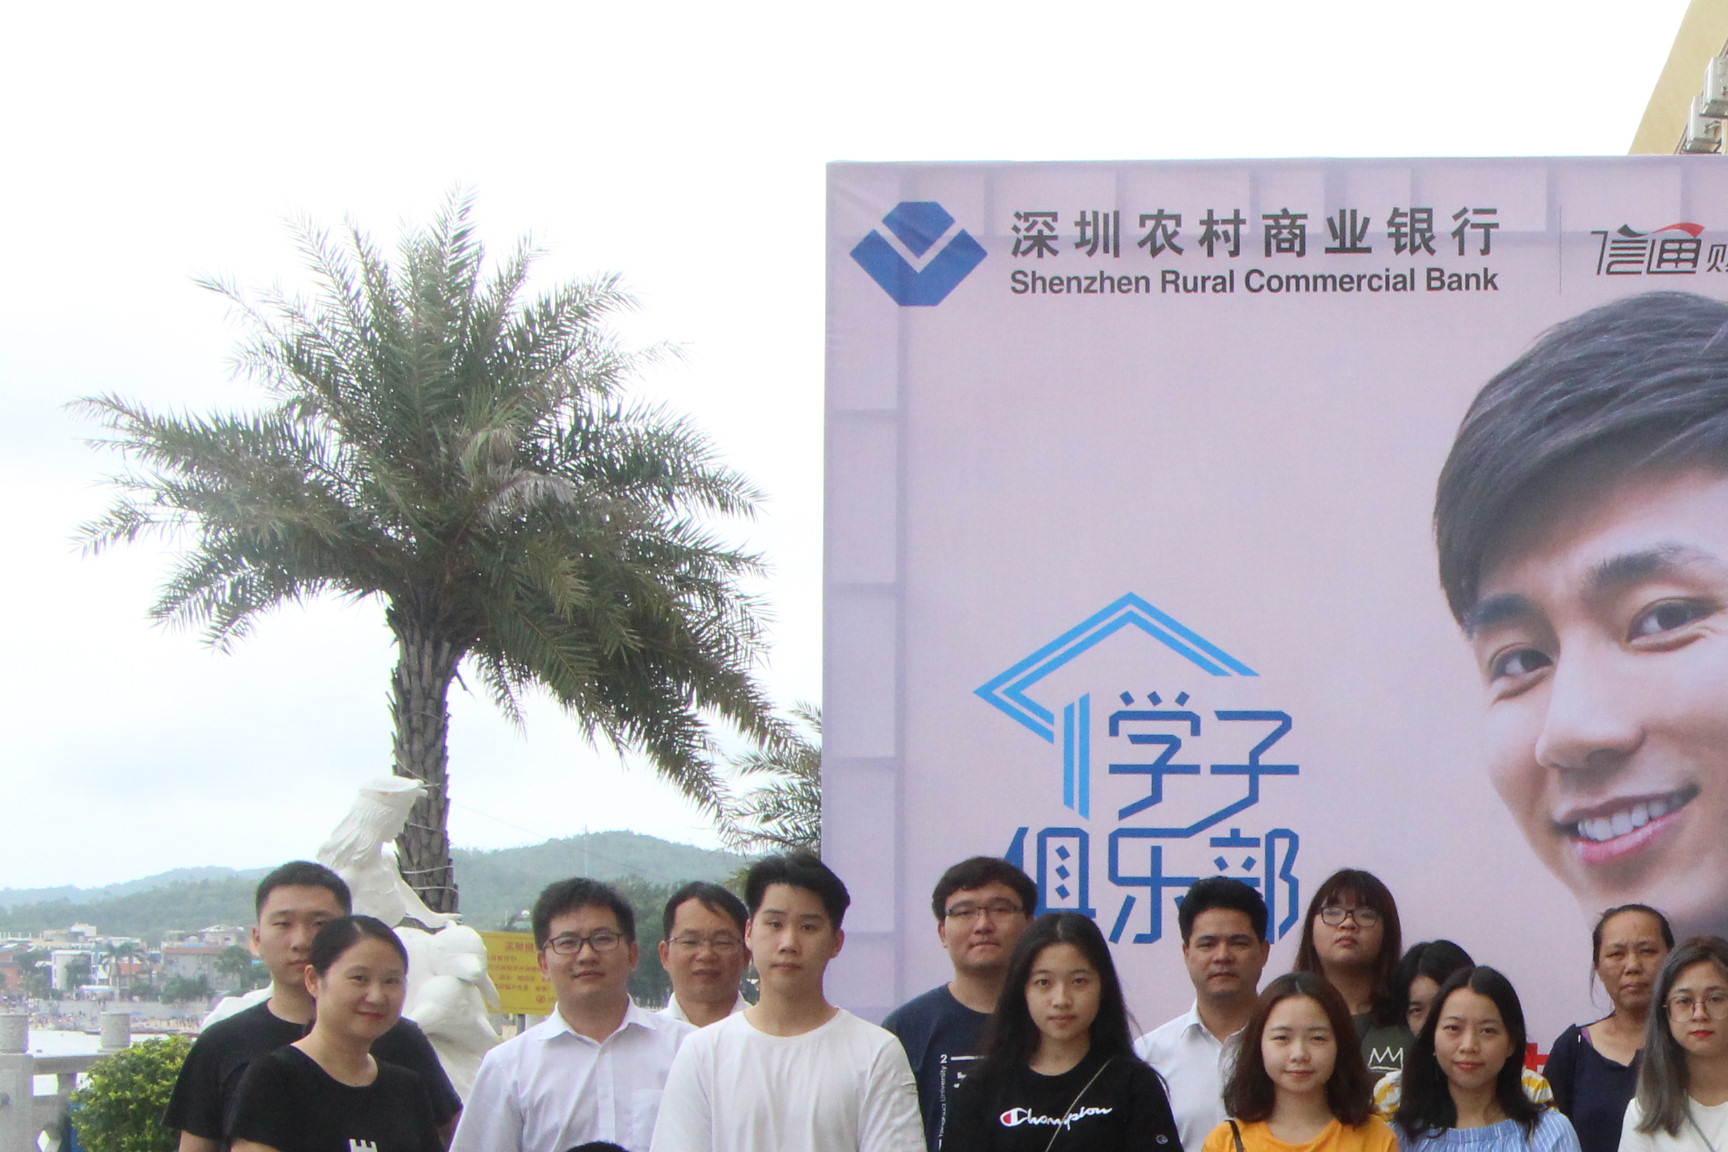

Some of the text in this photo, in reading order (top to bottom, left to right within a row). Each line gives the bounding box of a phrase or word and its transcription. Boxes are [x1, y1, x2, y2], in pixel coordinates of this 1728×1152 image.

[1010, 206, 1500, 258] 深圳农村商业银行
[1009, 268, 1500, 295] Shenzhen Rural Commercial Bank
[1108, 690, 1300, 825] 学子
[940, 1065, 948, 1102] University
[1000, 1106, 1113, 1130] Champion
